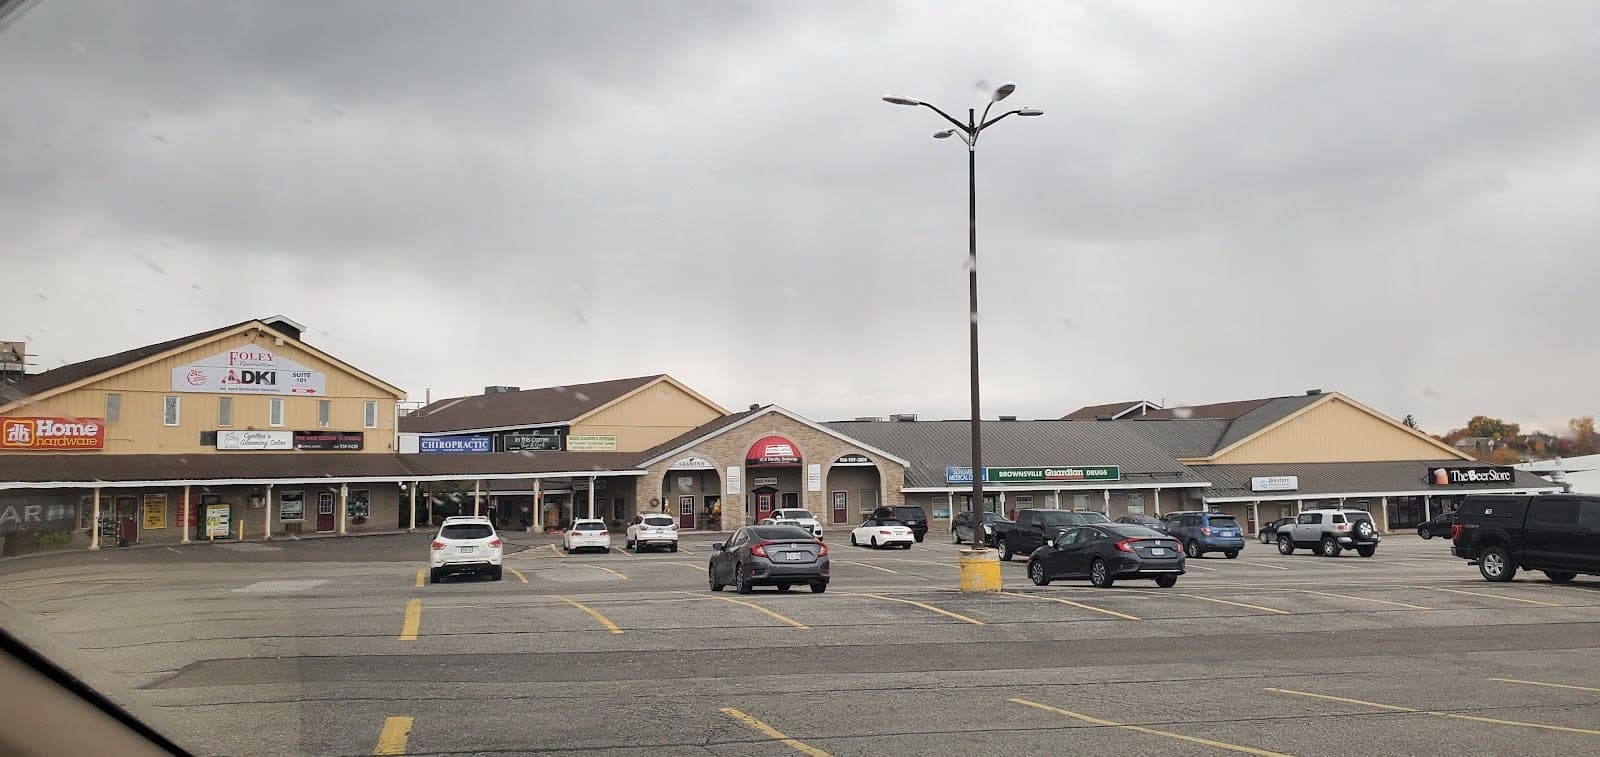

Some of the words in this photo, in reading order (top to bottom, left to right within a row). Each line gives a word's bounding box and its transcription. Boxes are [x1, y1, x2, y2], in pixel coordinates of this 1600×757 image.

[229, 351, 274, 366] FOLEY
[241, 370, 276, 385] DKI
[36, 420, 98, 436] Home
[36, 436, 97, 446] hardware
[244, 432, 271, 441] Cynthia's
[422, 441, 489, 449] CHIROPRACTIC
[1450, 470, 1468, 481] The
[1467, 470, 1488, 481] Beer
[1488, 470, 1510, 481] Store
